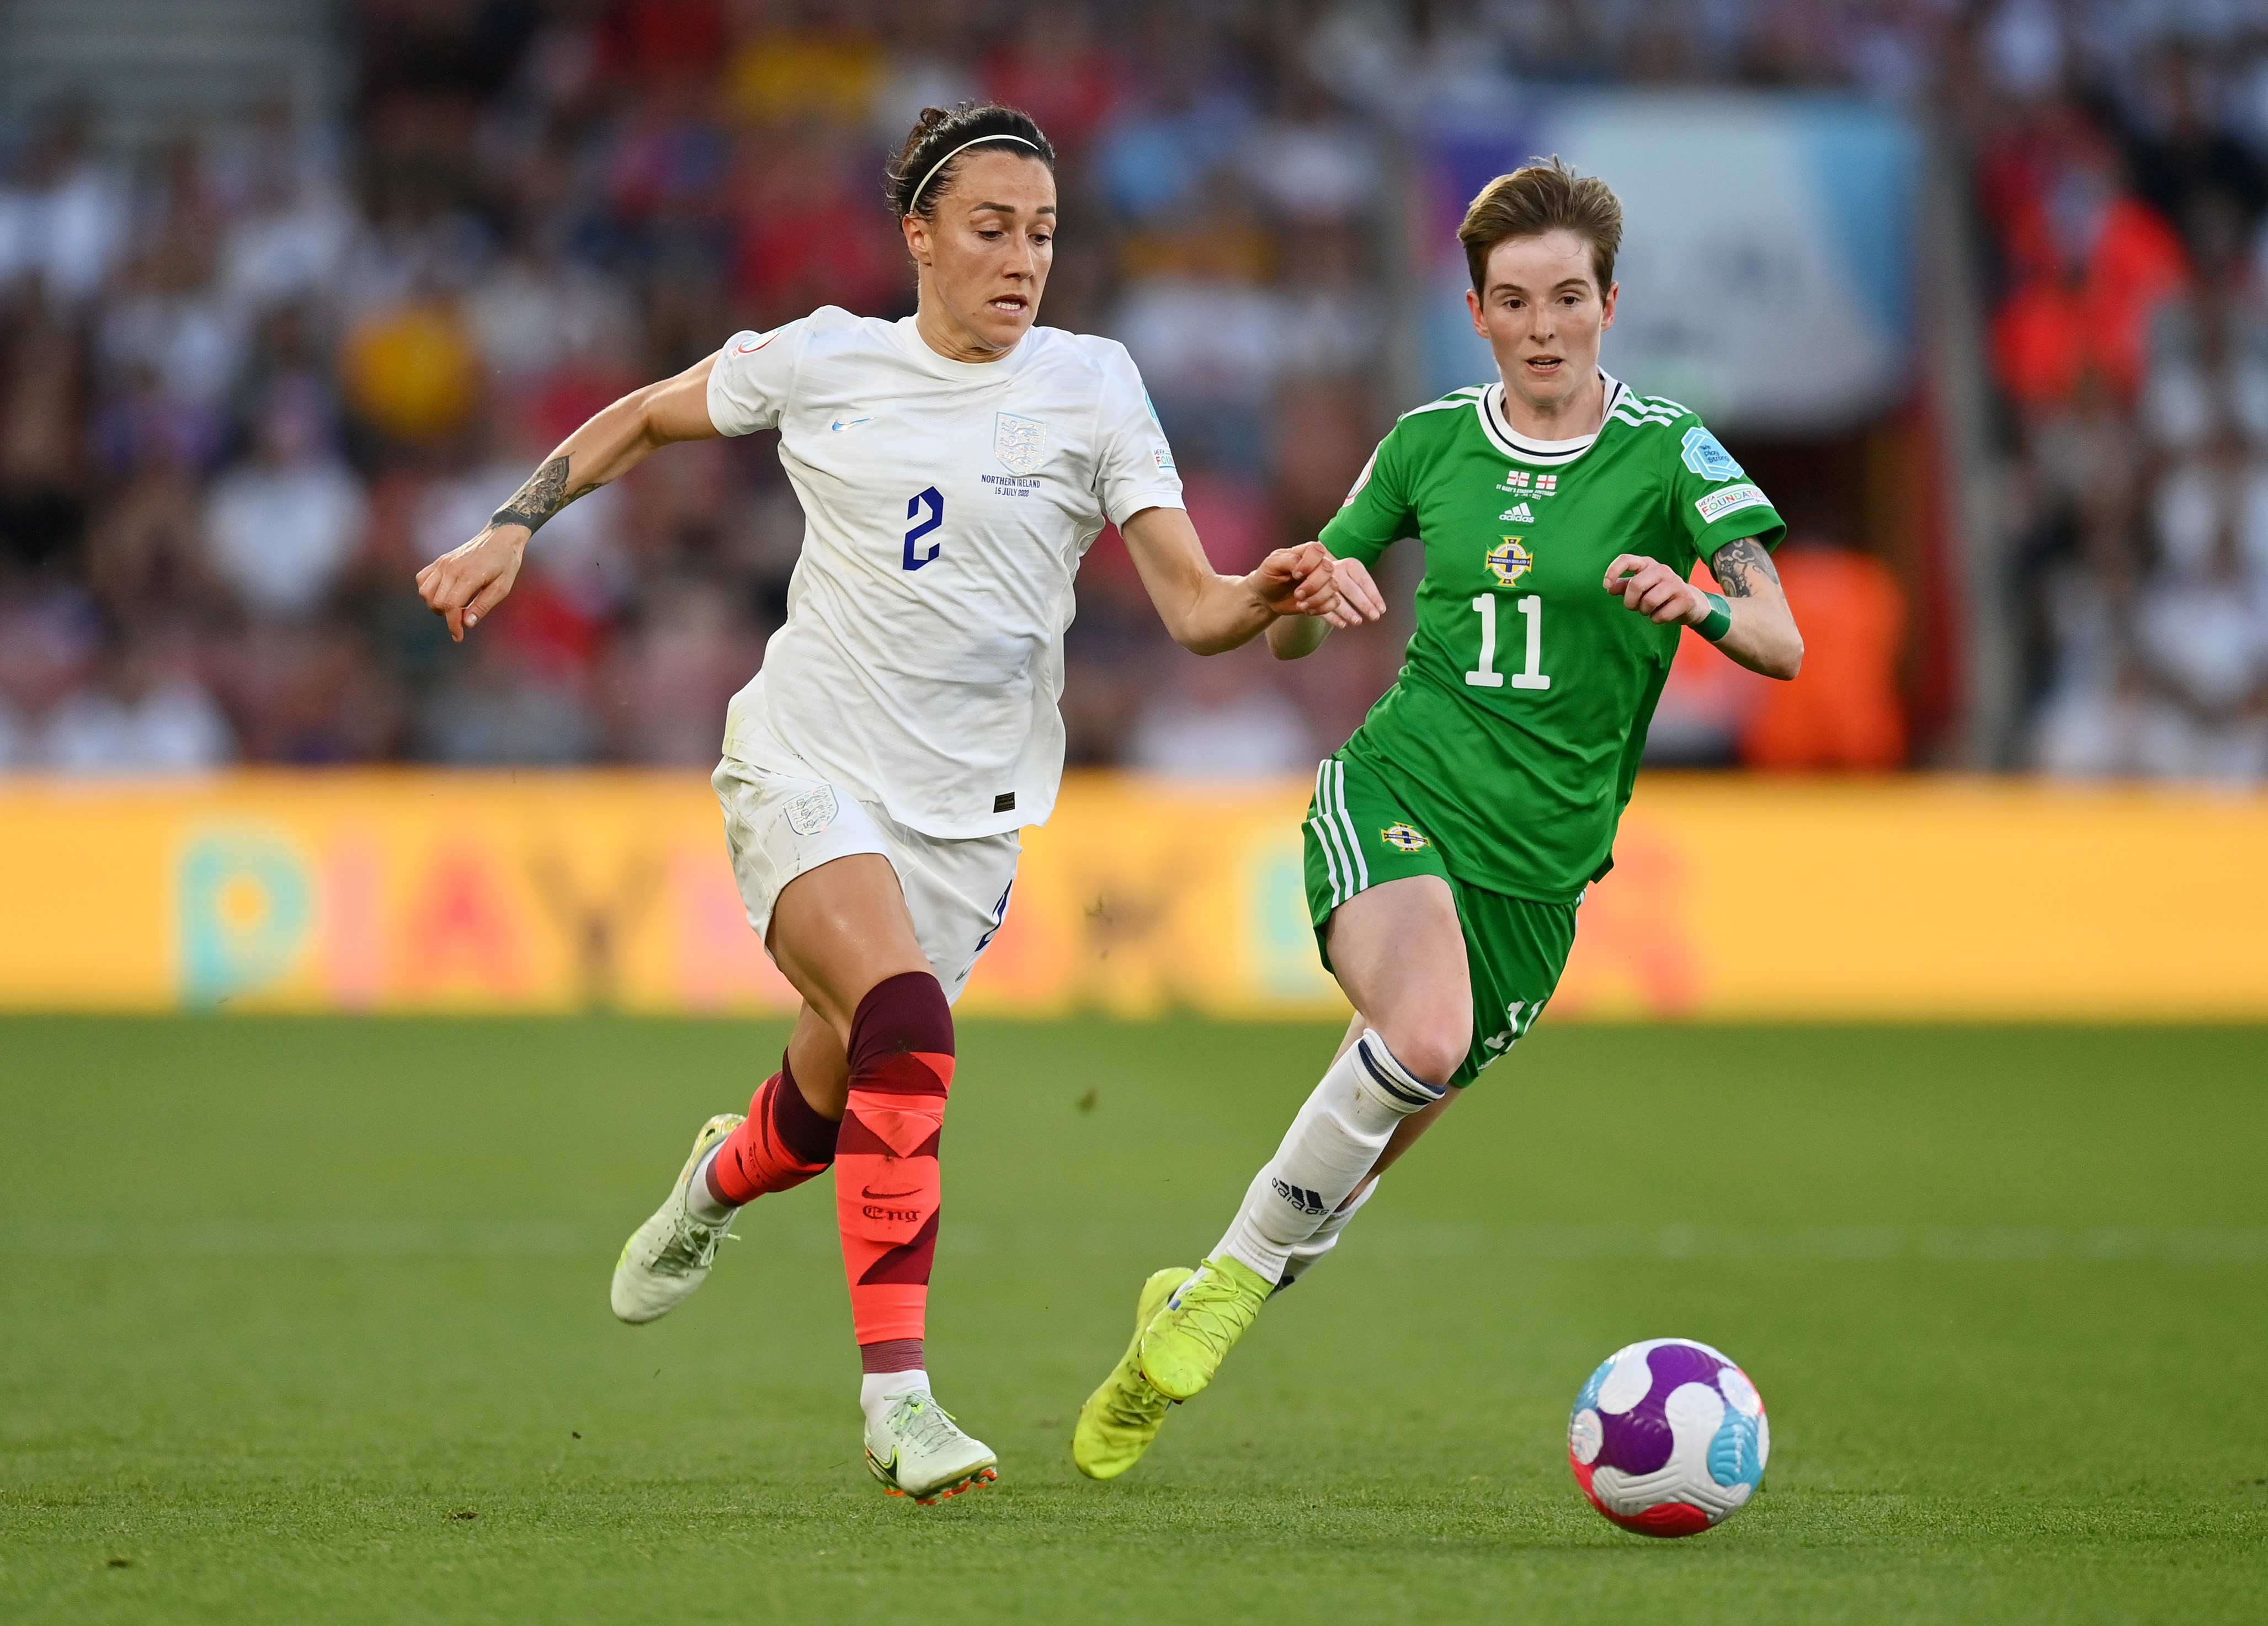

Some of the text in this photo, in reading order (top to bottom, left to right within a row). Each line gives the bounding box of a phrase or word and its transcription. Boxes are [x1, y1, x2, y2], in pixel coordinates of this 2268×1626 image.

[981, 475, 1040, 488] NORTHERN IRELAND
[1002, 488, 1017, 497] JULY
[1699, 495, 1716, 507] UEFA
[1499, 514, 1535, 523] adidas
[903, 486, 944, 571] 2
[1466, 593, 1550, 690] 11
[1272, 1177, 1329, 1215] adidas
[863, 1206, 921, 1222] Eng
